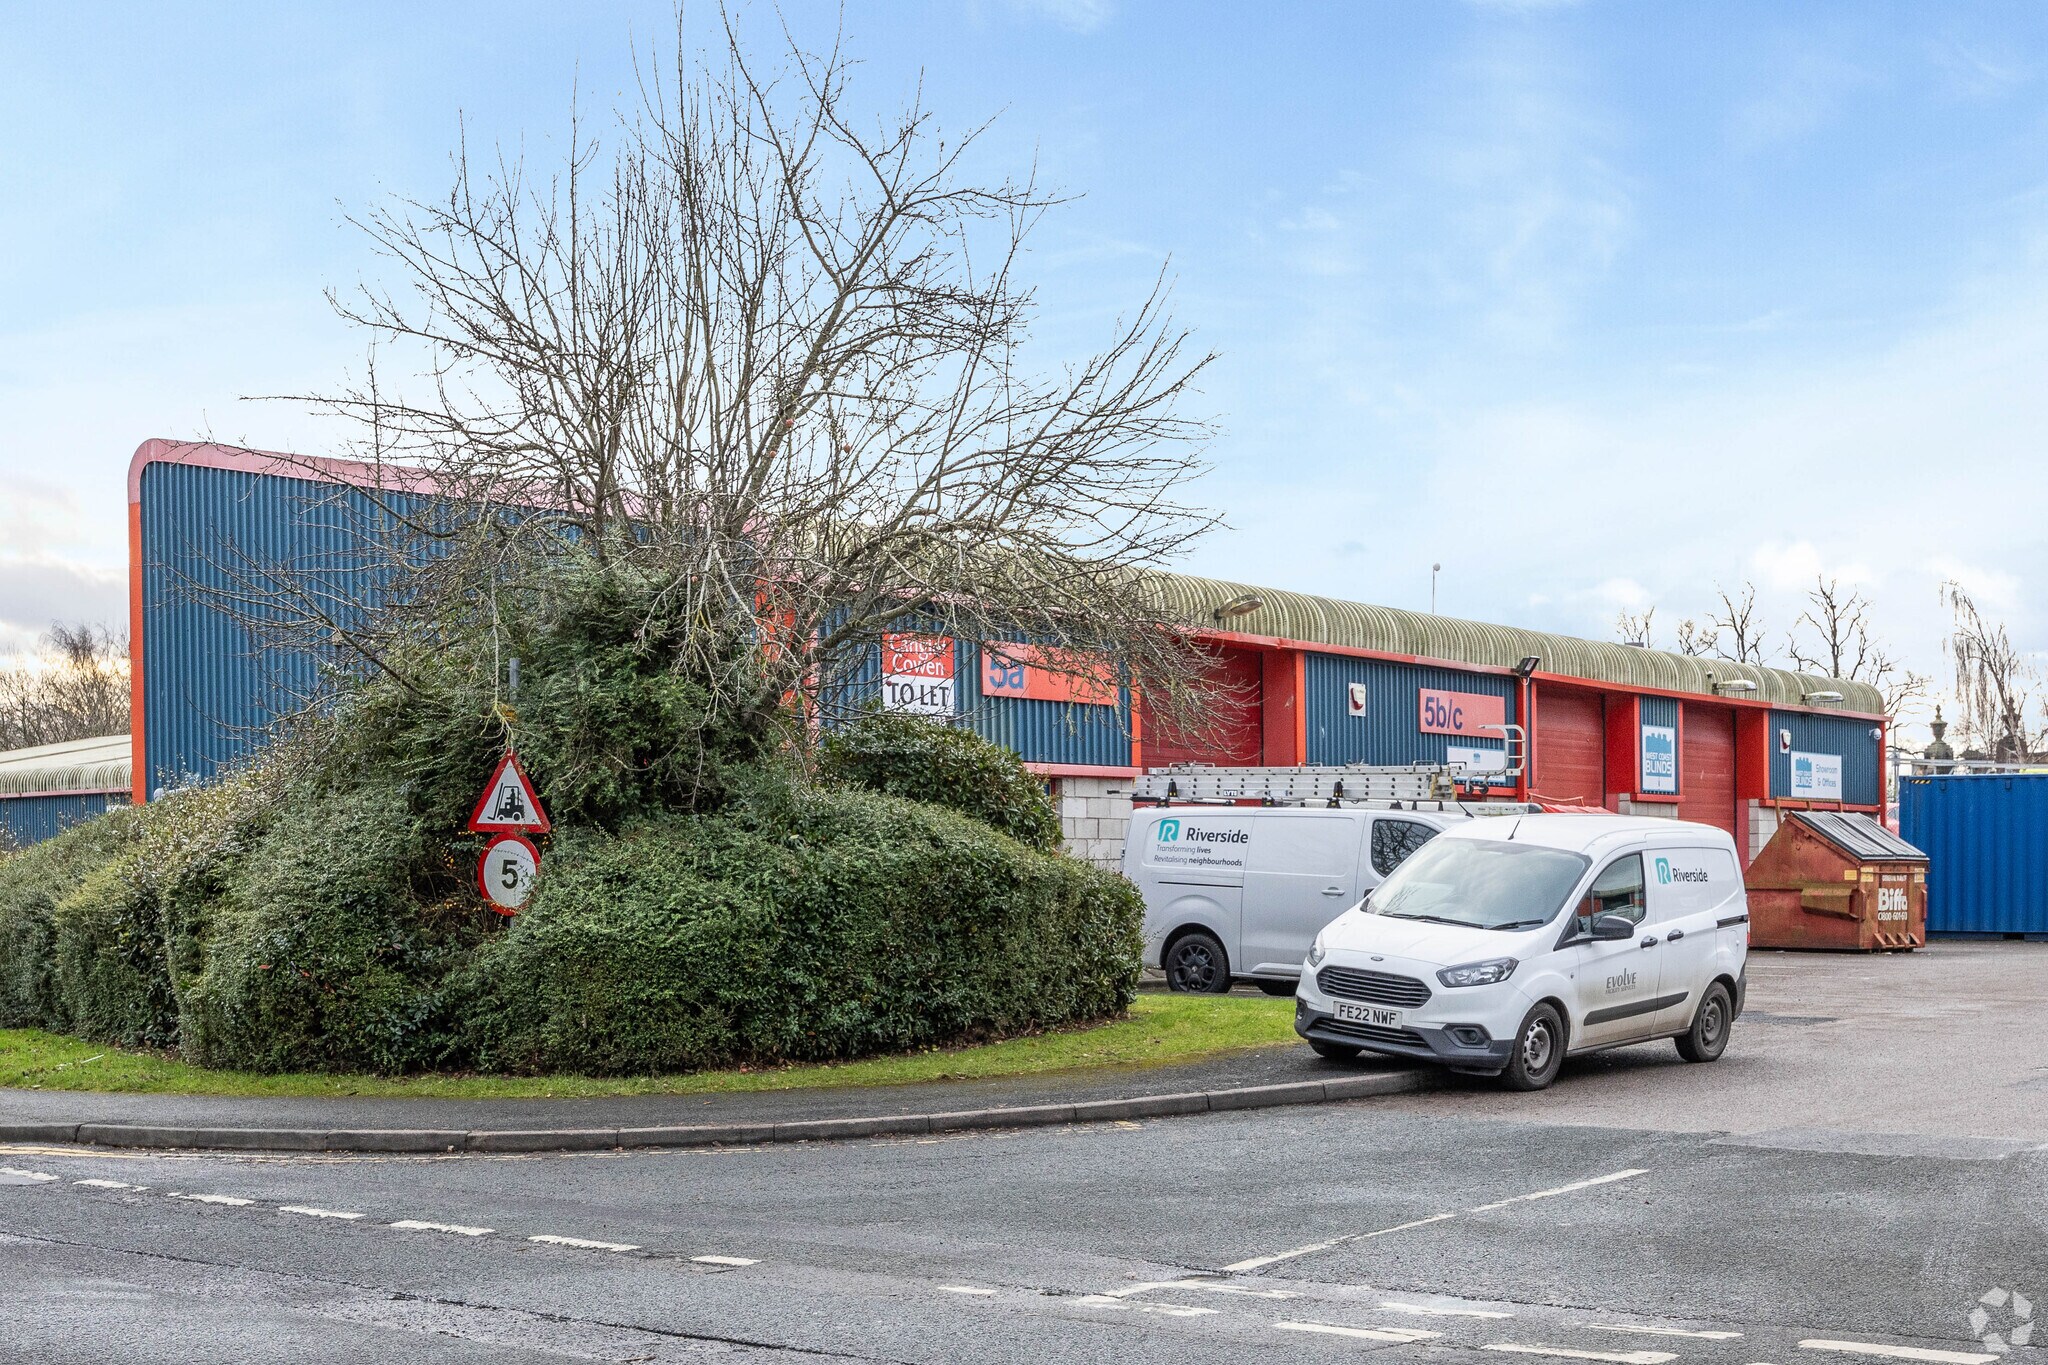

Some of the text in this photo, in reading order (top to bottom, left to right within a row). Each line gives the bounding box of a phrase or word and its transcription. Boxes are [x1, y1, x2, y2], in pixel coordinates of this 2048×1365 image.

[892, 653, 944, 676] Cowen
[989, 651, 1024, 689] 5a
[890, 682, 949, 707] TO LET
[1425, 696, 1463, 730] 5b/c
[1646, 760, 1671, 774] BLINDS
[1186, 827, 1249, 844] Riverside
[1156, 844, 1212, 855] Transforming lives
[1154, 855, 1243, 867] Revitalising neighbourhoods
[501, 859, 518, 889] 5
[1672, 867, 1708, 882] Riverside
[1878, 887, 1908, 911] Biffa
[1606, 967, 1637, 989] EVOLVE
[1339, 1004, 1397, 1025] FE22 NWF
